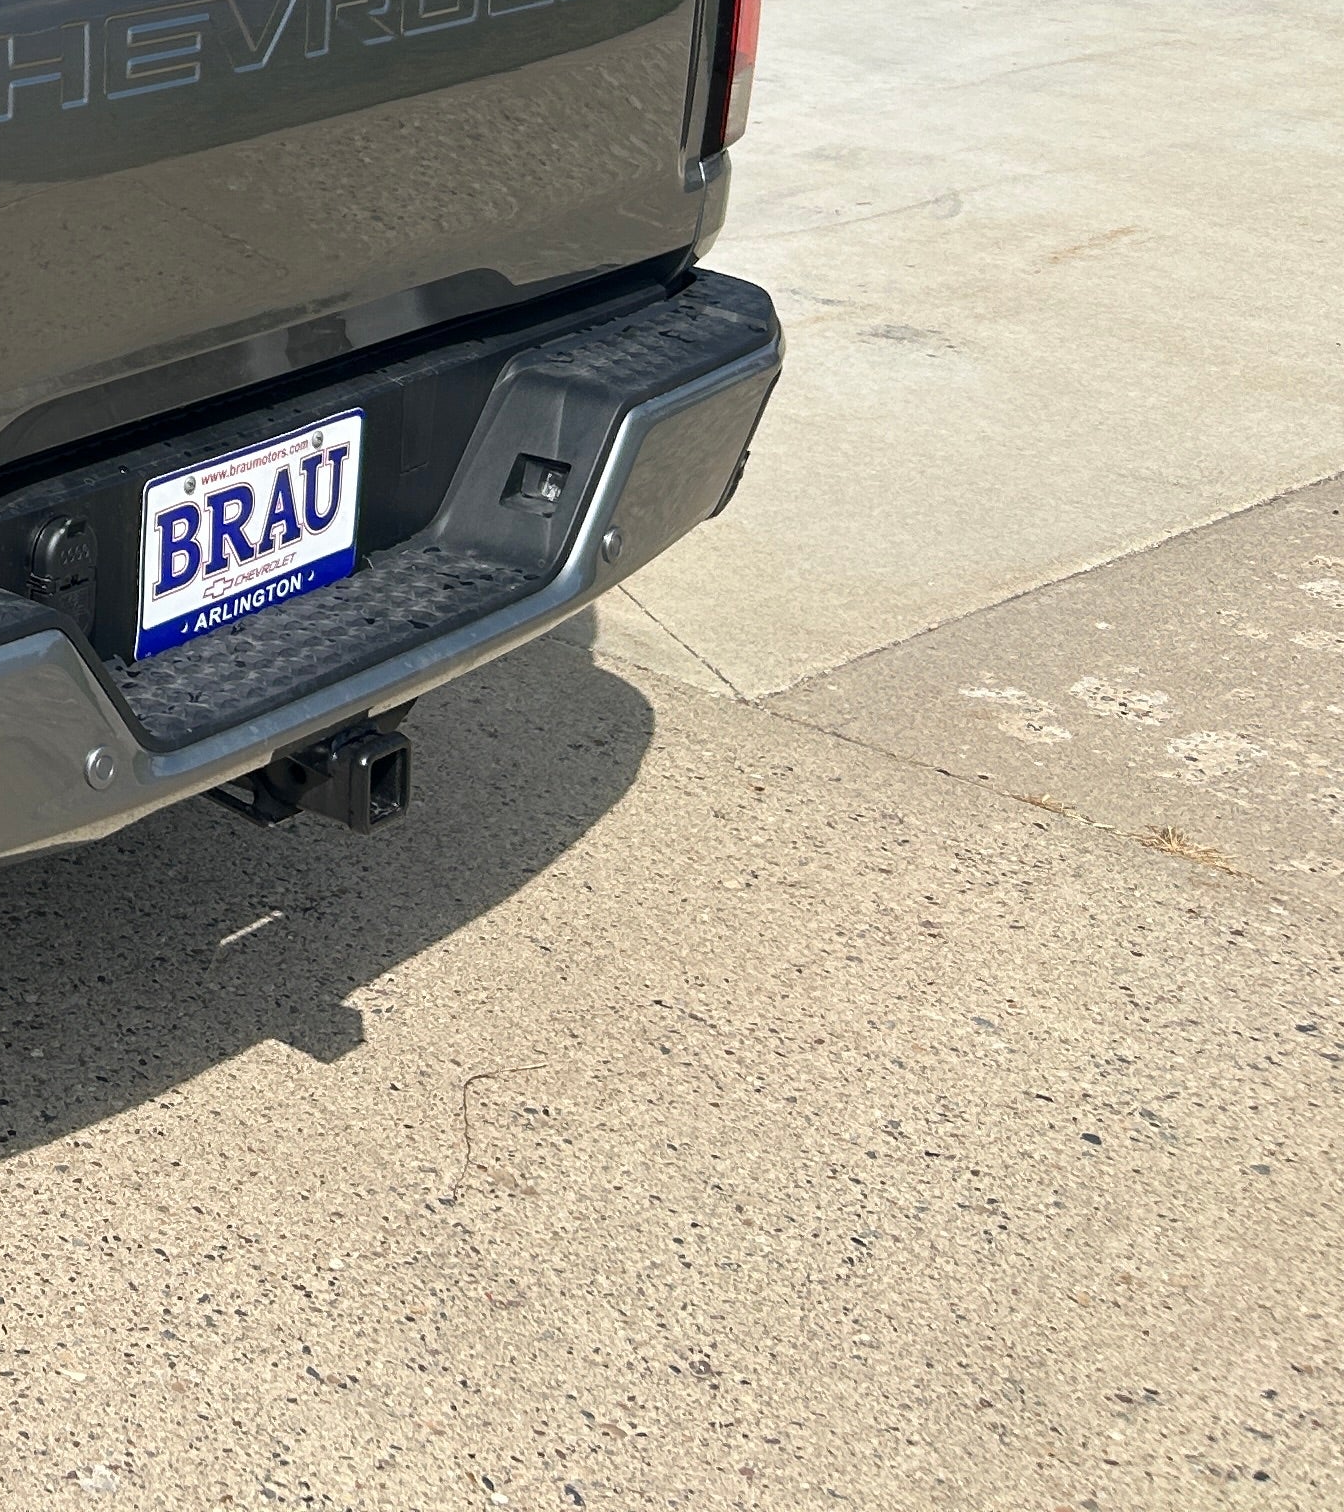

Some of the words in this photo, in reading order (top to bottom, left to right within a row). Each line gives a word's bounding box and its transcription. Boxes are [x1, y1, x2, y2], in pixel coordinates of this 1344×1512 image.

[200, 439, 310, 486] www.braumotors.com
[152, 441, 351, 603] BRAU
[233, 551, 298, 588] CHEVROLET
[192, 572, 303, 633] ARLINGTON
